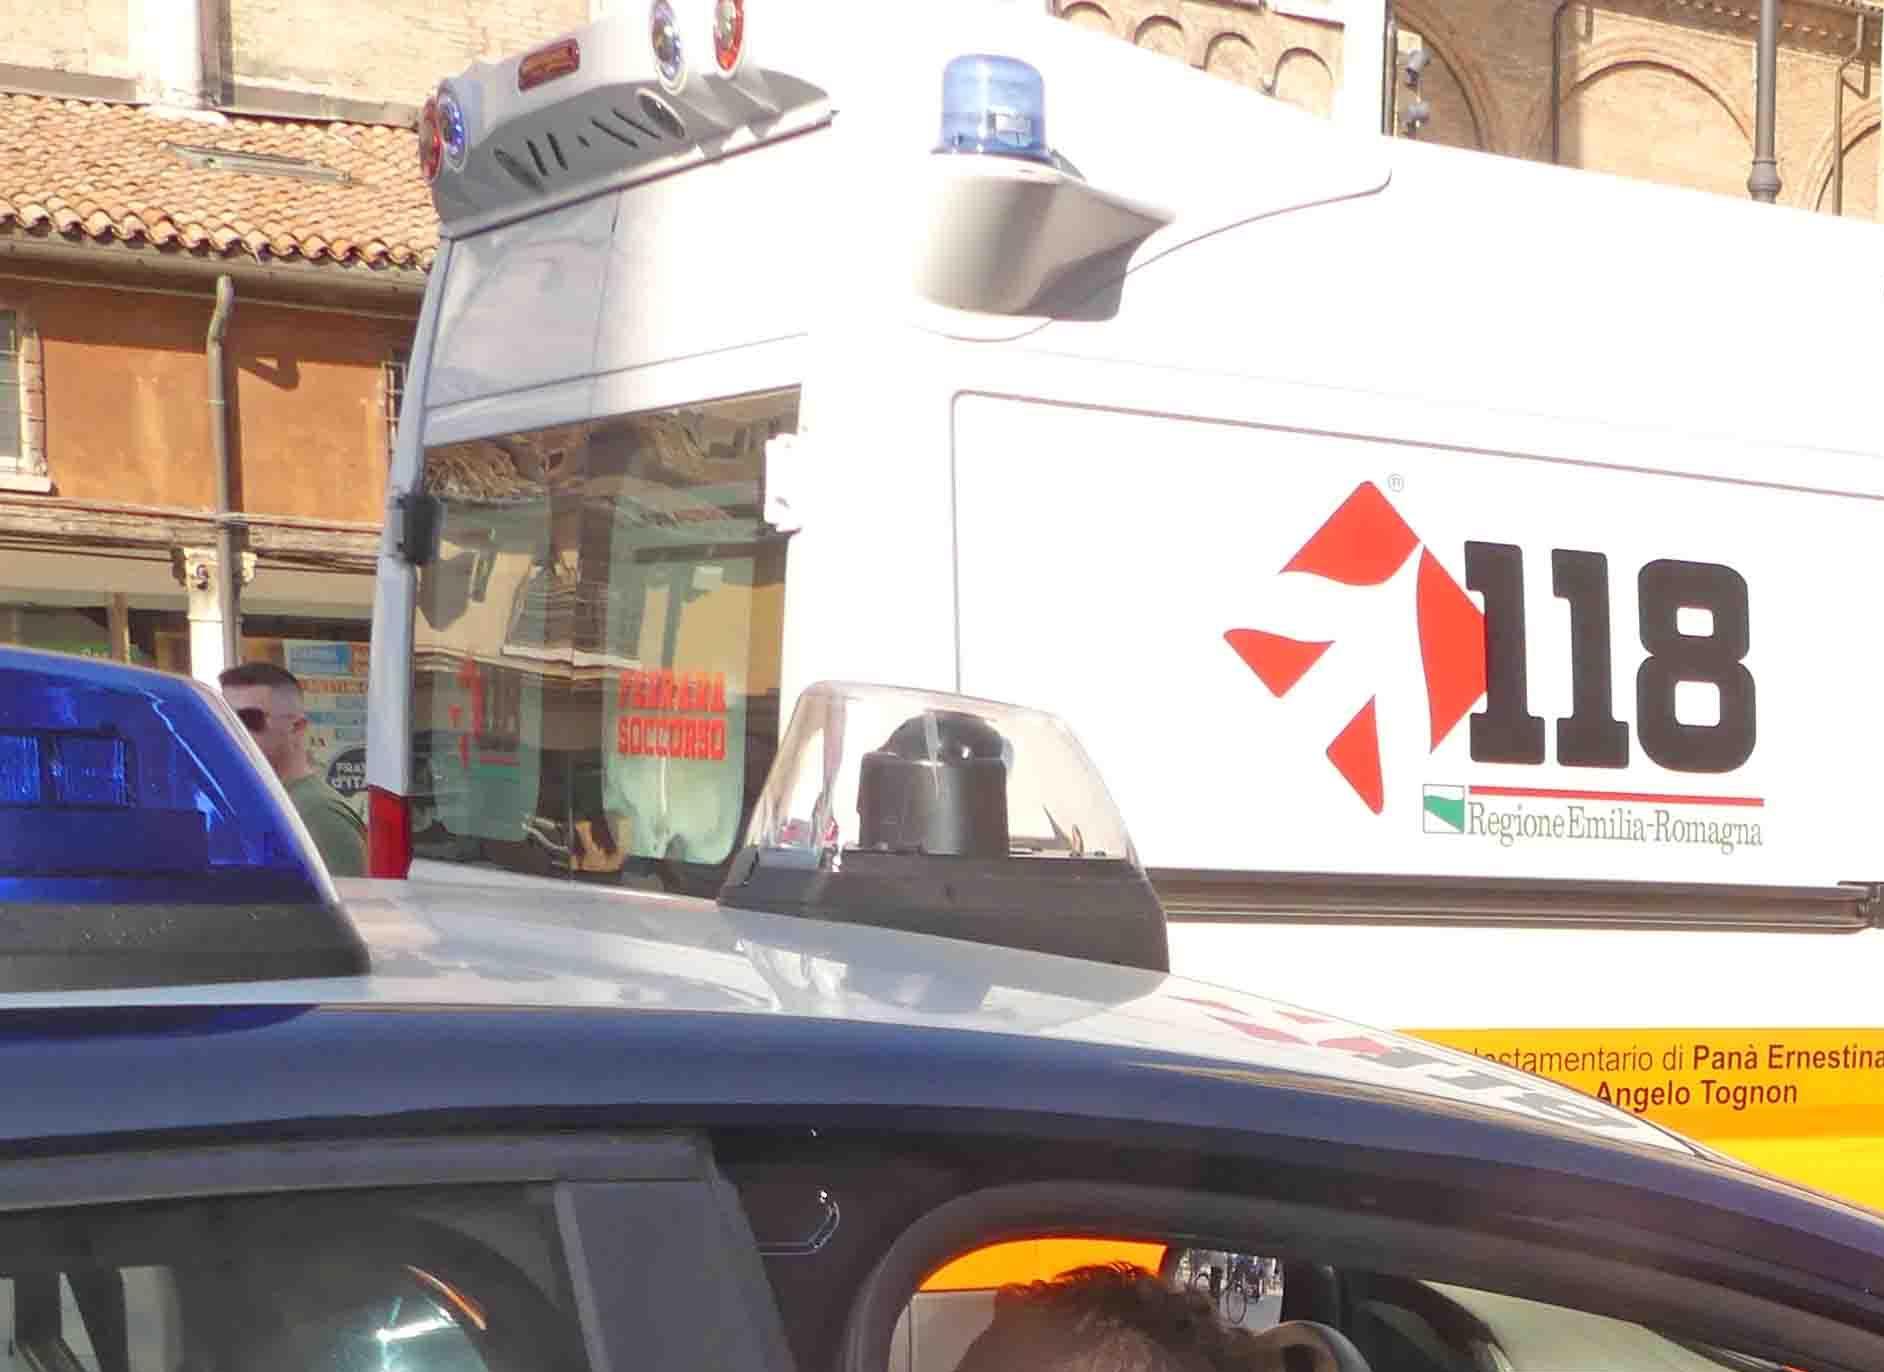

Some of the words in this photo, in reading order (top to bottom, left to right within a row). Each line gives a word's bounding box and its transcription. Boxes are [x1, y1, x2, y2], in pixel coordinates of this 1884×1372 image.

[1464, 540, 1757, 774] 118
[1467, 801, 1565, 848] Regione
[1567, 805, 1763, 855] Emilia-Romagna
[1662, 1044, 1685, 1071] di
[1692, 1043, 1759, 1071] Panà
[1596, 1080, 1690, 1114] Angelo
[1700, 1079, 1798, 1111] Tognon
